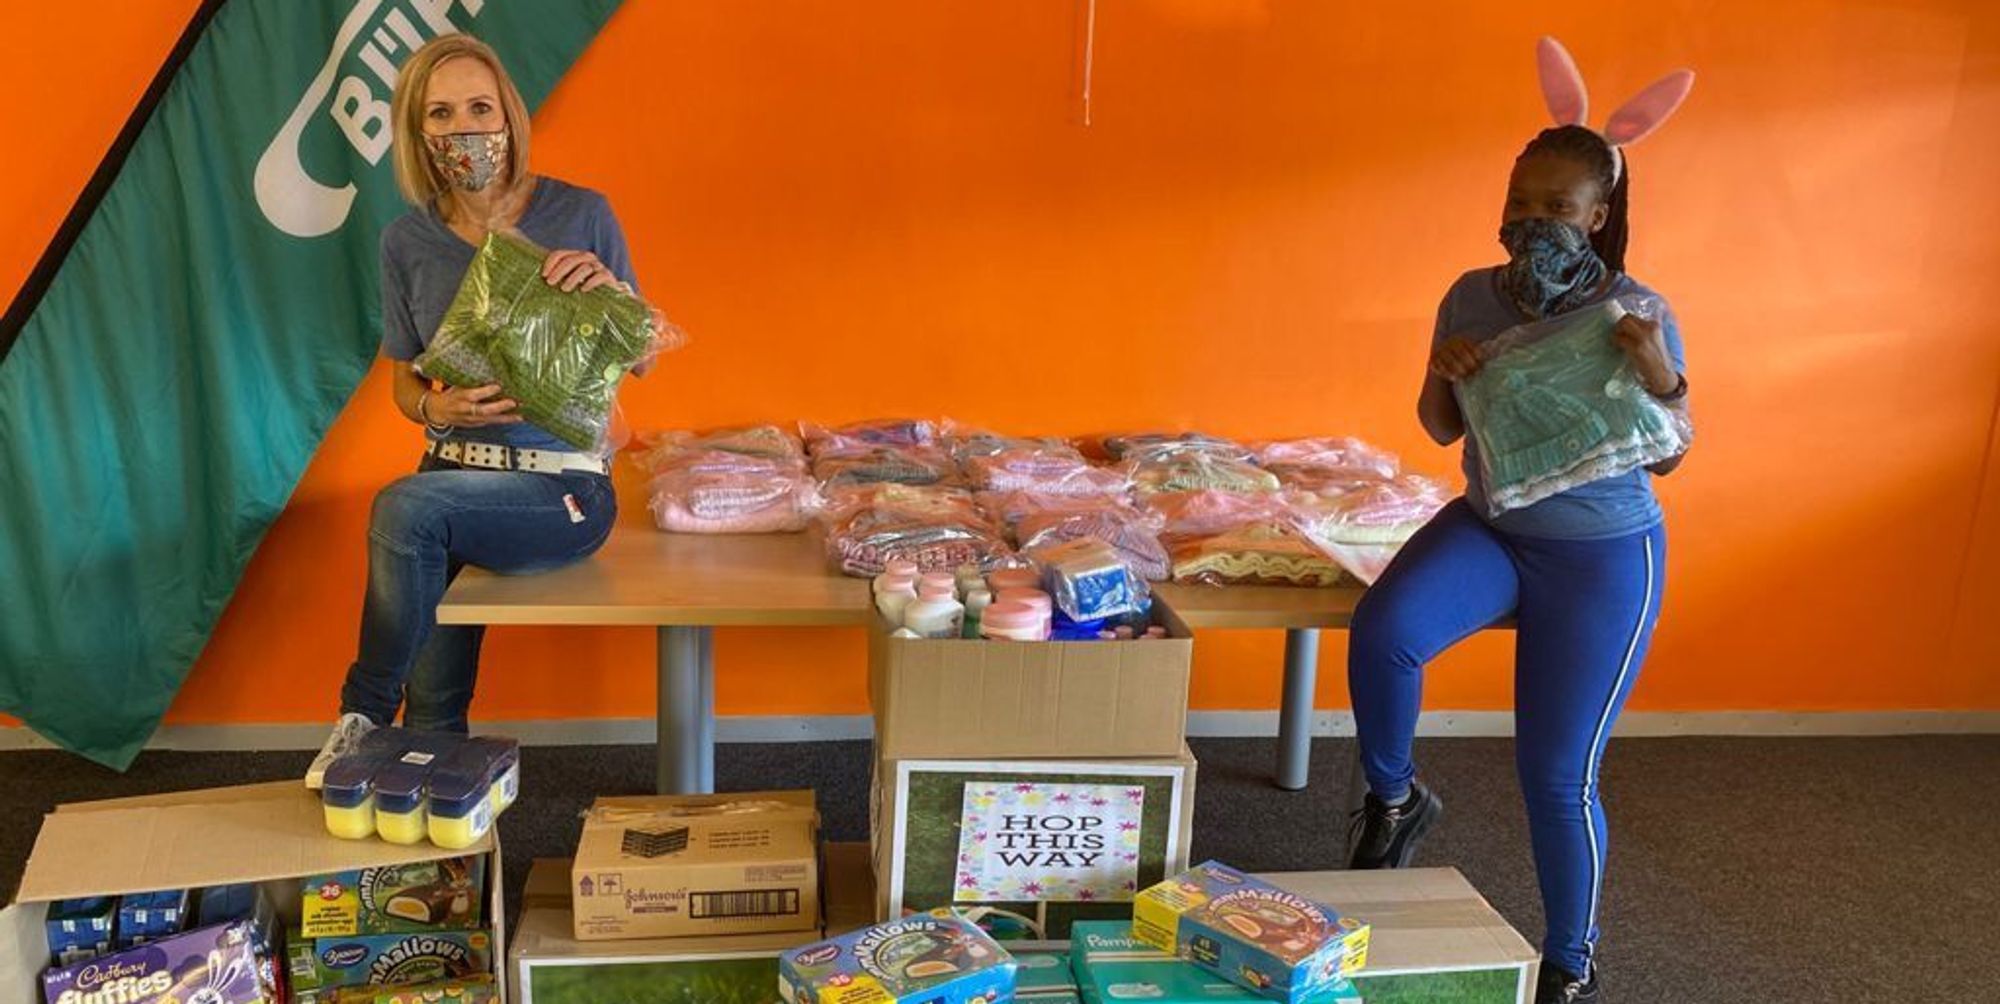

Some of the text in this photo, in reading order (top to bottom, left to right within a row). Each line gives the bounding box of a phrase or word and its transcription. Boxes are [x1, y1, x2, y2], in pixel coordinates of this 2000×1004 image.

[1002, 815, 1103, 831] HOP
[996, 833, 1105, 850] THIS
[995, 852, 1105, 867] WAY
[76, 961, 147, 988] Cadbury
